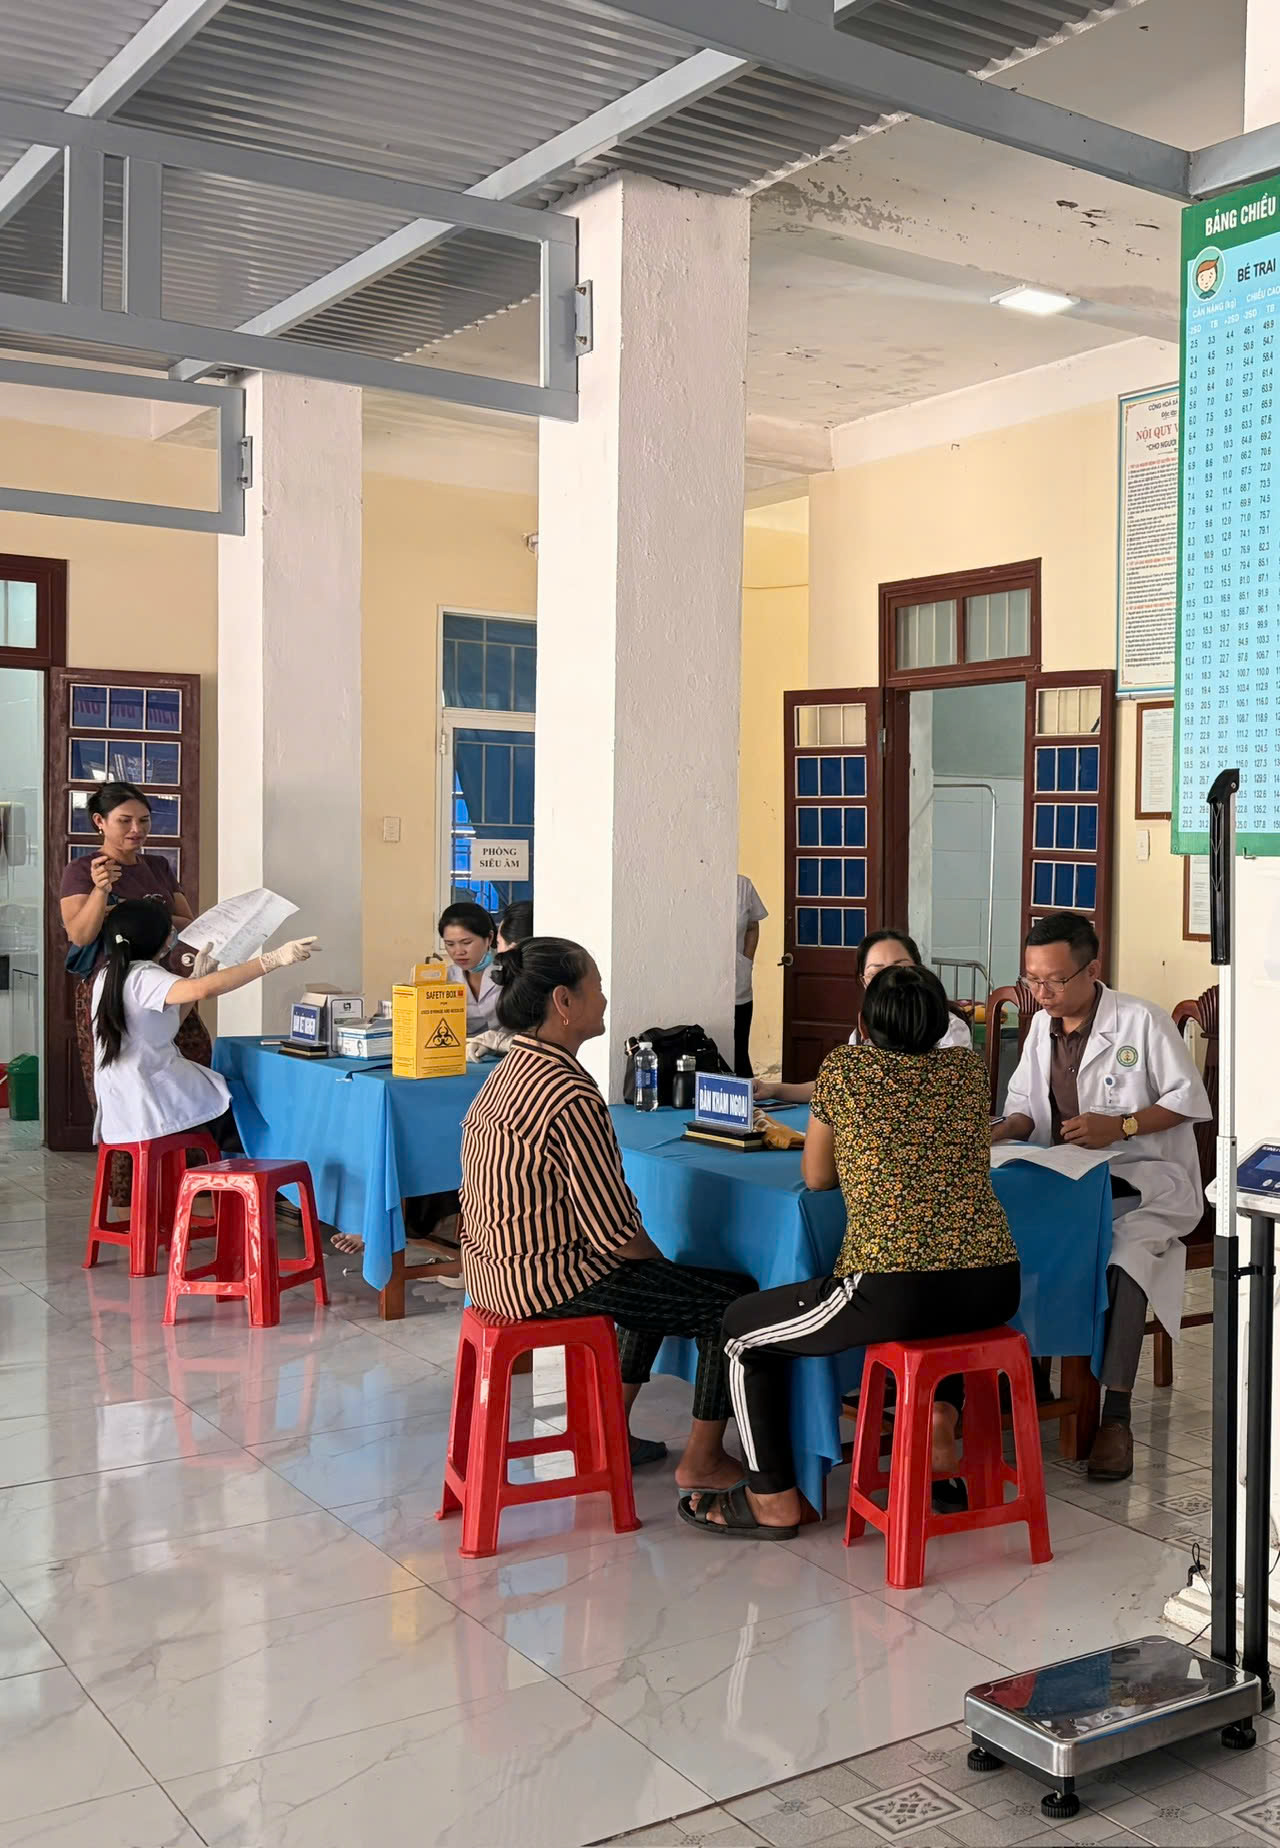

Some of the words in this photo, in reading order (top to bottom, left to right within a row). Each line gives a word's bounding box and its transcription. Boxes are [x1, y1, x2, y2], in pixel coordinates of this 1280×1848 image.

[1205, 208, 1237, 236] BẢNG
[1240, 193, 1276, 225] CHIỀU
[1237, 263, 1250, 282] BÉ
[1254, 258, 1276, 278] TRAI
[482, 846, 517, 856] PHÒNG
[480, 859, 502, 868] SIÊU
[504, 858, 520, 868] ÂM
[426, 991, 445, 1000] SAFETY
[446, 990, 457, 999] BOX
